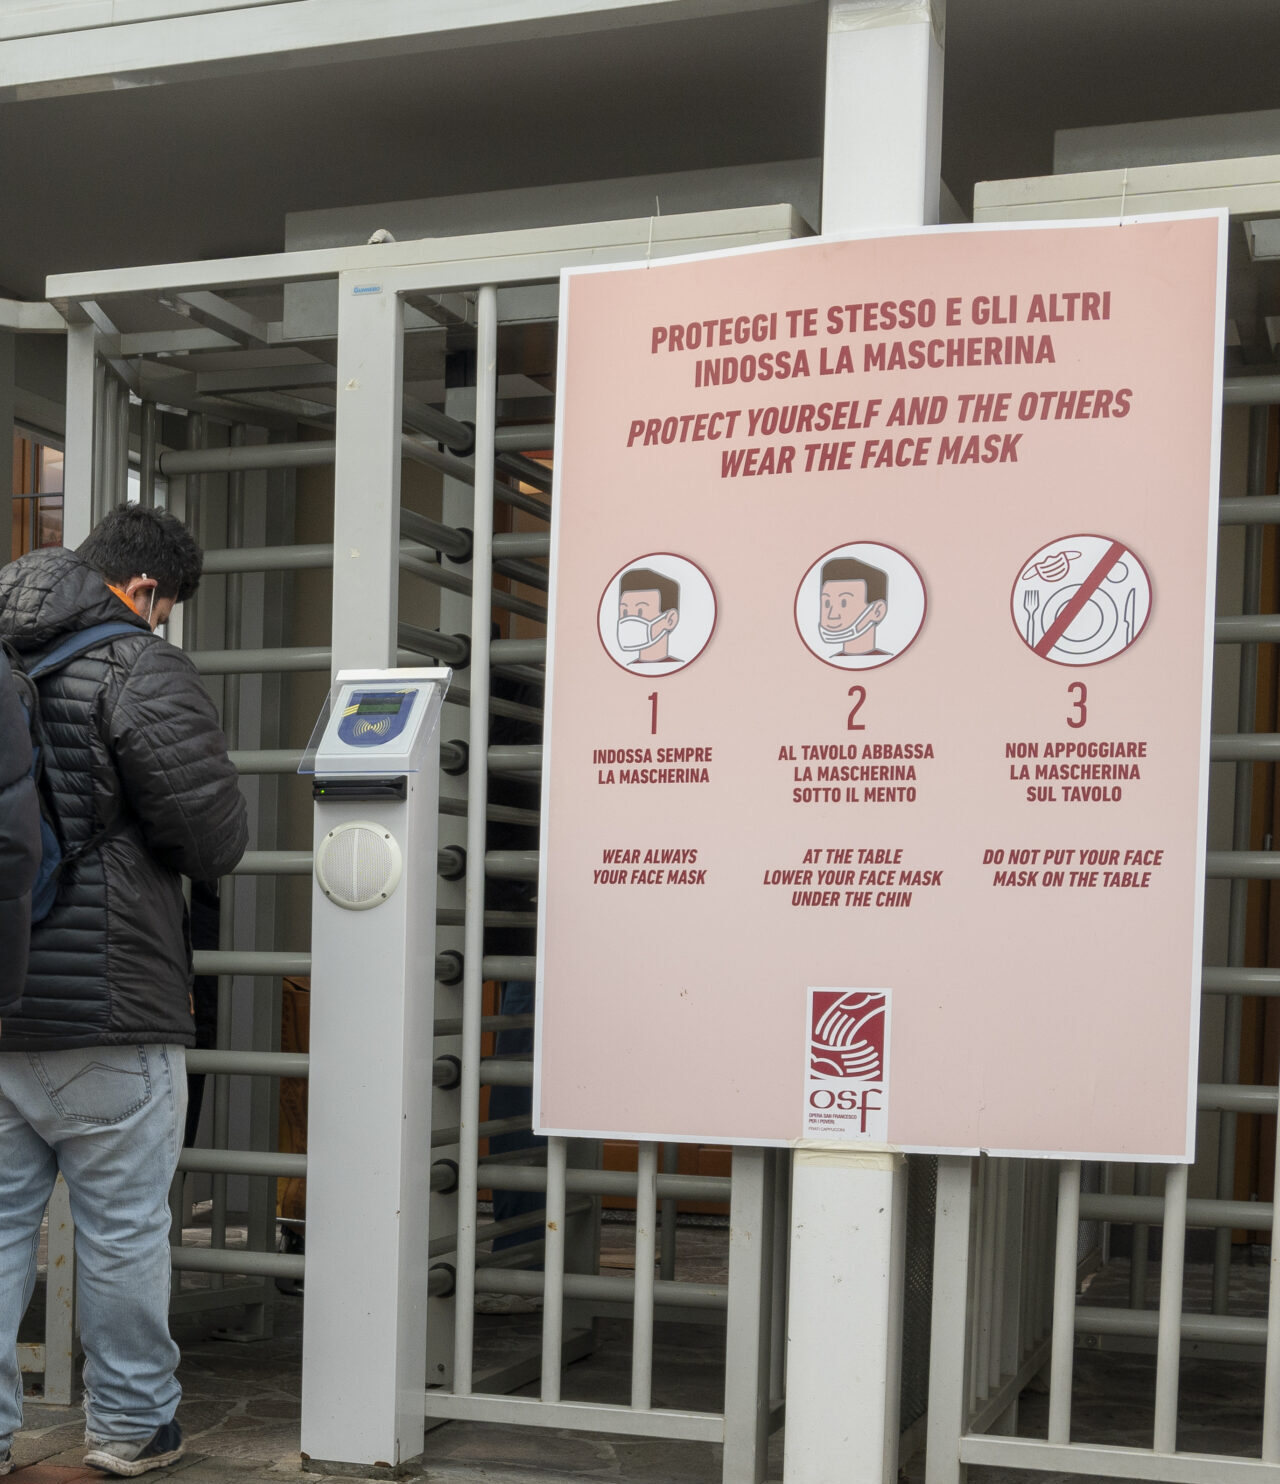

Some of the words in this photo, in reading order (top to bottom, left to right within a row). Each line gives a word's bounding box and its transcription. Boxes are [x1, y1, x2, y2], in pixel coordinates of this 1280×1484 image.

[652, 313, 779, 355] PROTEGGI
[786, 308, 818, 338] TE
[827, 299, 936, 334] STESSO
[946, 297, 962, 326] E
[972, 295, 1017, 325] GLI
[1027, 291, 1110, 323] ALTRI
[693, 348, 810, 387] INDOSSA
[820, 346, 854, 375] LA
[864, 335, 1055, 372] MASCHERINA
[627, 410, 741, 447] PROTECT
[749, 399, 882, 436] YOURSELF
[886, 396, 948, 426] AND
[958, 393, 1012, 423] THE
[1018, 389, 1132, 421] OTHERS
[722, 446, 796, 478] WEAR
[805, 441, 855, 472] THE
[861, 437, 931, 468] FACE
[937, 434, 1022, 464] MASK
[648, 692, 658, 734] 1
[848, 686, 866, 730] 2
[1067, 682, 1087, 728] 3
[593, 749, 652, 763] INDOSSA
[657, 747, 712, 763] SEMPRE
[779, 746, 796, 760] AL
[802, 744, 856, 760] TAVOLO
[862, 744, 934, 759] ABBASSA
[1006, 743, 1038, 758] NON
[1043, 742, 1146, 758] APPOGGIARE
[599, 770, 615, 784] LA
[620, 768, 709, 784] MASCHERINA
[795, 767, 812, 781] LA
[818, 765, 916, 781] MASCHERINA
[1010, 765, 1030, 780] LA
[1035, 764, 1140, 780] MASCHERINA
[794, 788, 841, 802] SOTTO
[846, 788, 858, 802] IL
[864, 787, 916, 802] MENTO
[1027, 786, 1056, 802] SUL
[1063, 786, 1121, 802] TAVOLO
[603, 849, 640, 864] WEAR
[644, 849, 696, 864] ALWAYS
[804, 849, 822, 864] AT
[827, 849, 853, 864] THE
[859, 849, 903, 864] TABLE
[983, 849, 1004, 864] DO
[1008, 850, 1040, 864] NOT
[1043, 850, 1074, 864] PUT
[1080, 850, 1119, 865] YOUR
[1124, 850, 1162, 865] FACE
[594, 870, 627, 884] YOUR
[631, 870, 664, 884] FACE
[667, 870, 706, 884] MASK
[764, 870, 813, 885] LOWER
[818, 870, 855, 885] YOUR
[859, 870, 896, 885] FACE
[899, 871, 942, 885] MASK
[994, 872, 1037, 886] MASK
[1043, 872, 1064, 886] ON
[1070, 872, 1098, 887] THE
[1104, 872, 1150, 887] TABLE
[792, 892, 840, 906] UNDER
[846, 892, 872, 906] THE
[876, 892, 912, 907] CHIN
[809, 1088, 883, 1133] osf
